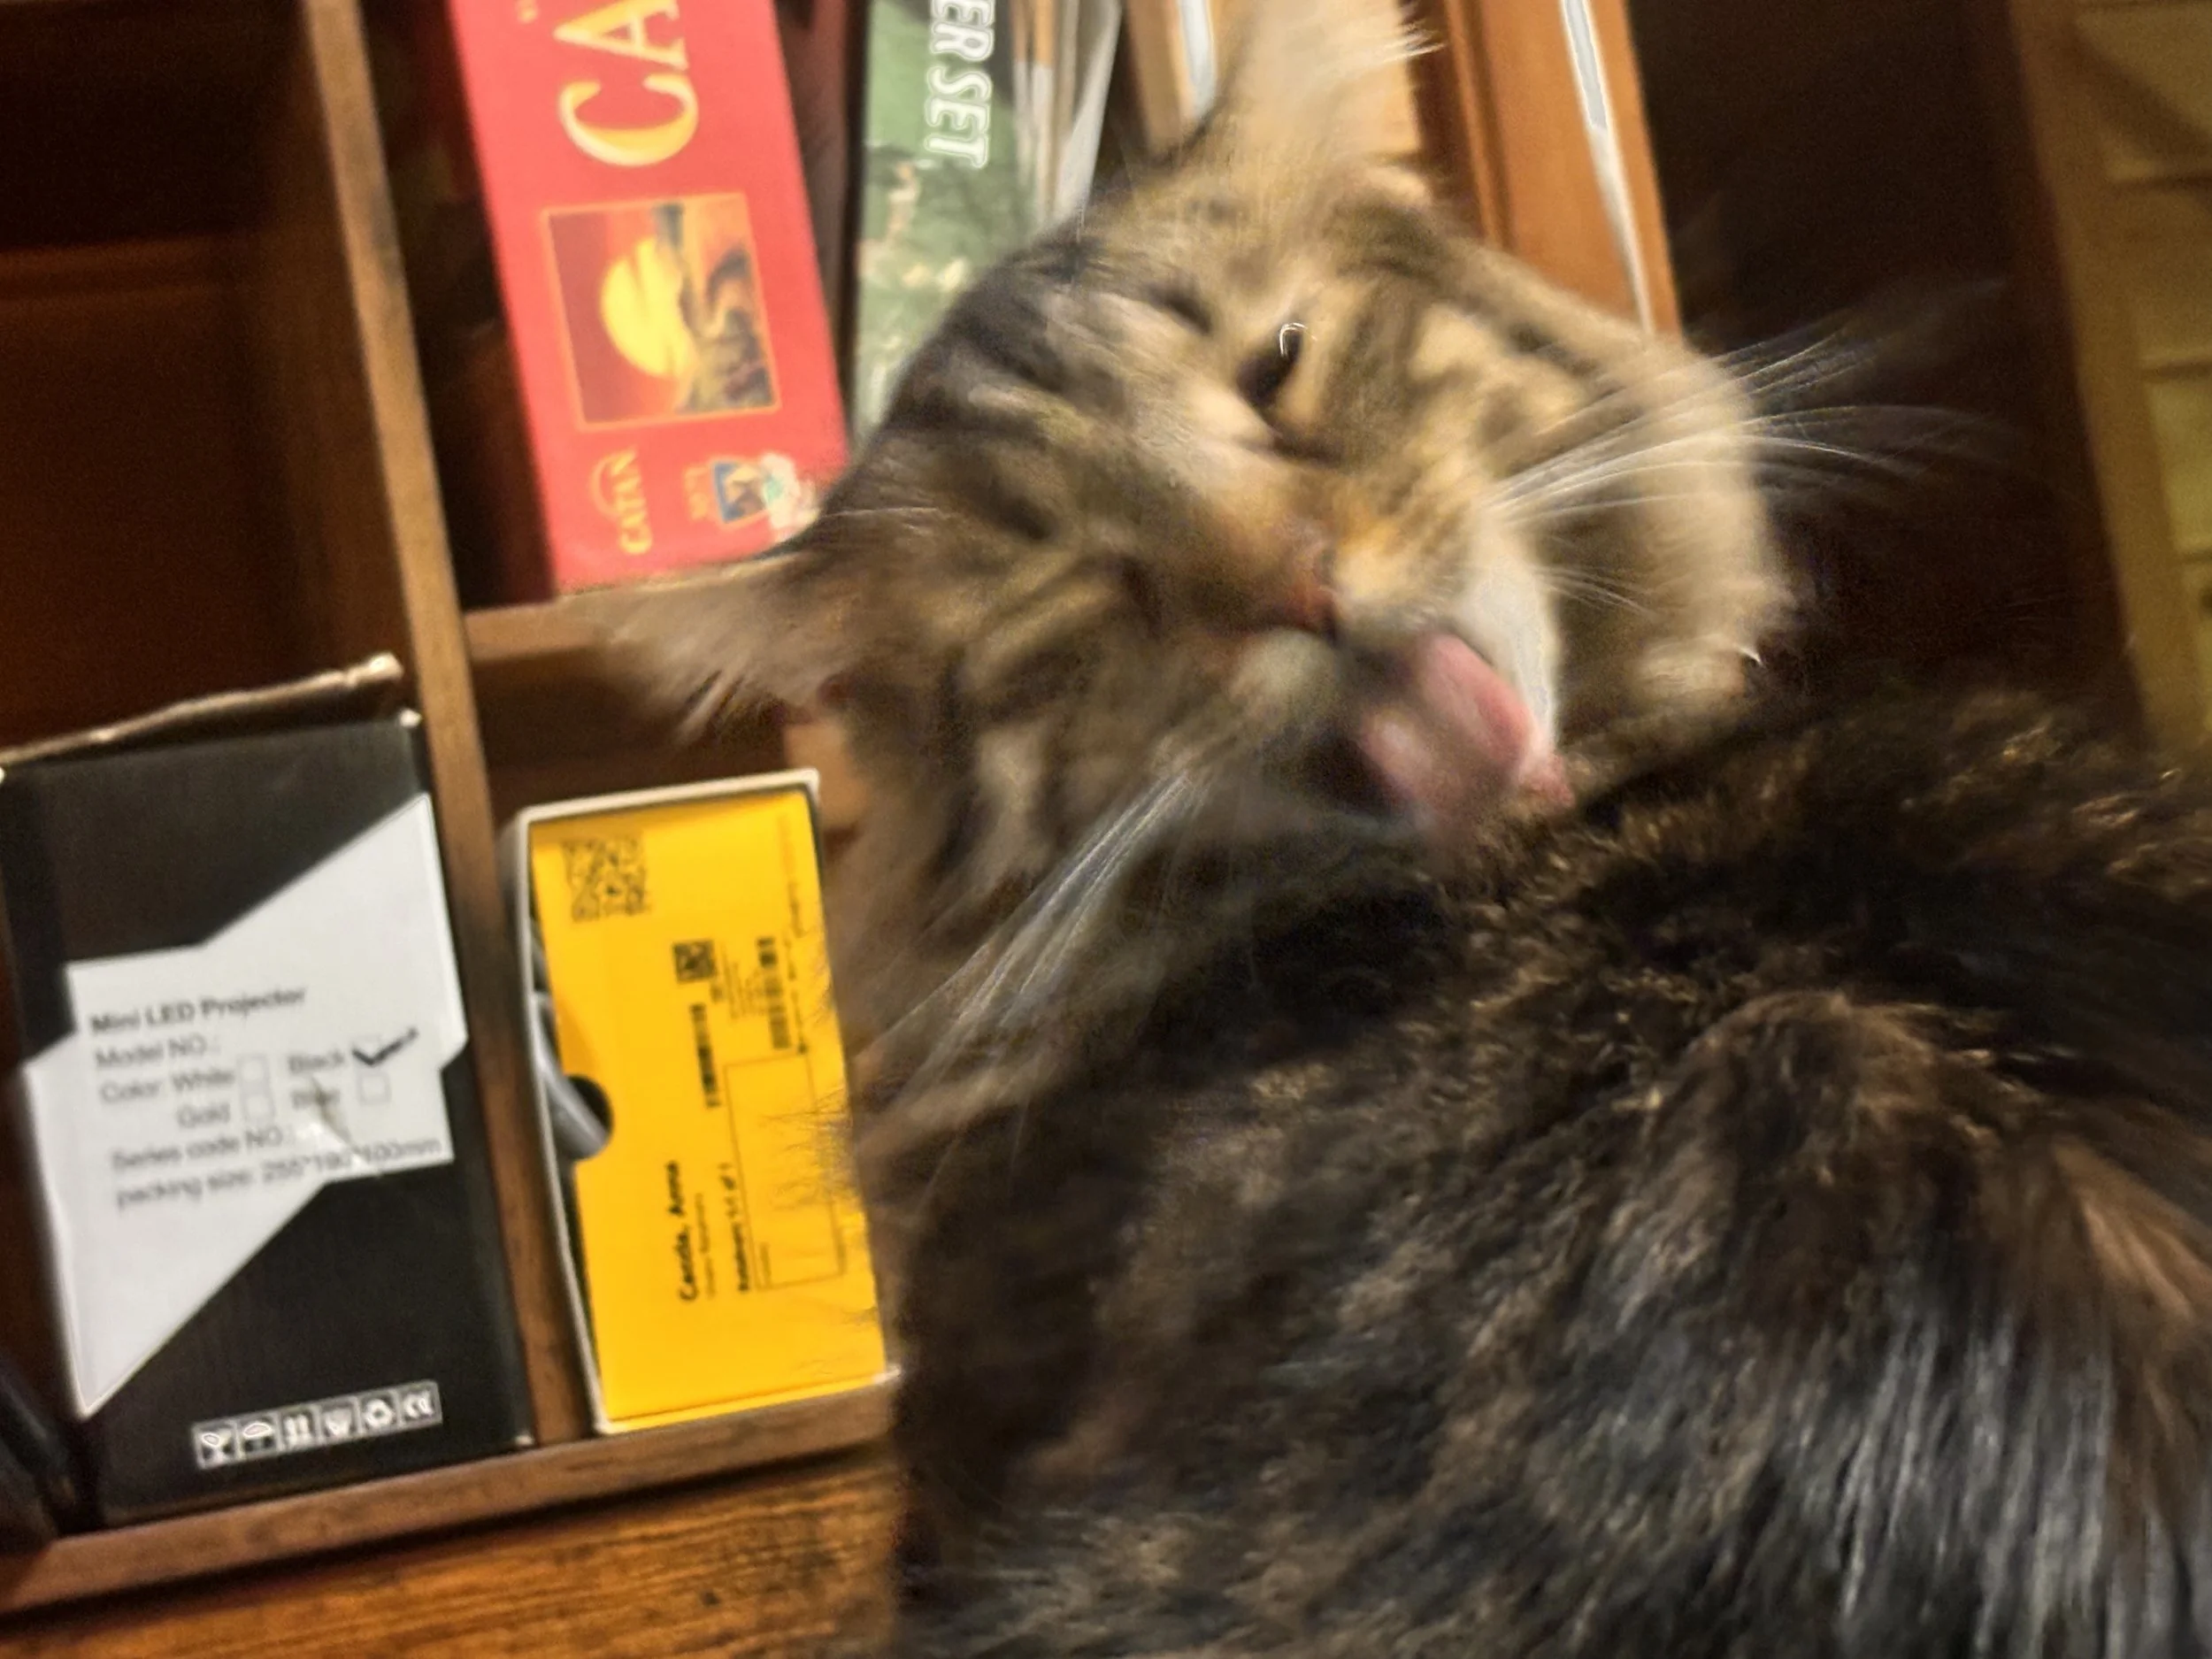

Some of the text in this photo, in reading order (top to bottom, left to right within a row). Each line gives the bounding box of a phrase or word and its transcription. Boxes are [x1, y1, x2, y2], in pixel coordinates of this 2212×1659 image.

[553, 0, 697, 167] CA
[926, 65, 992, 168] SET
[611, 447, 652, 555] CATAN
[91, 985, 306, 1033] Mini LED Projector
[96, 1042, 165, 1069] Model
[172, 1067, 235, 1092] White
[288, 1048, 345, 1074] Black
[178, 1102, 231, 1129] Gold
[112, 1146, 182, 1171] Series
[186, 1134, 240, 1160] code
[116, 1175, 204, 1210] packing
